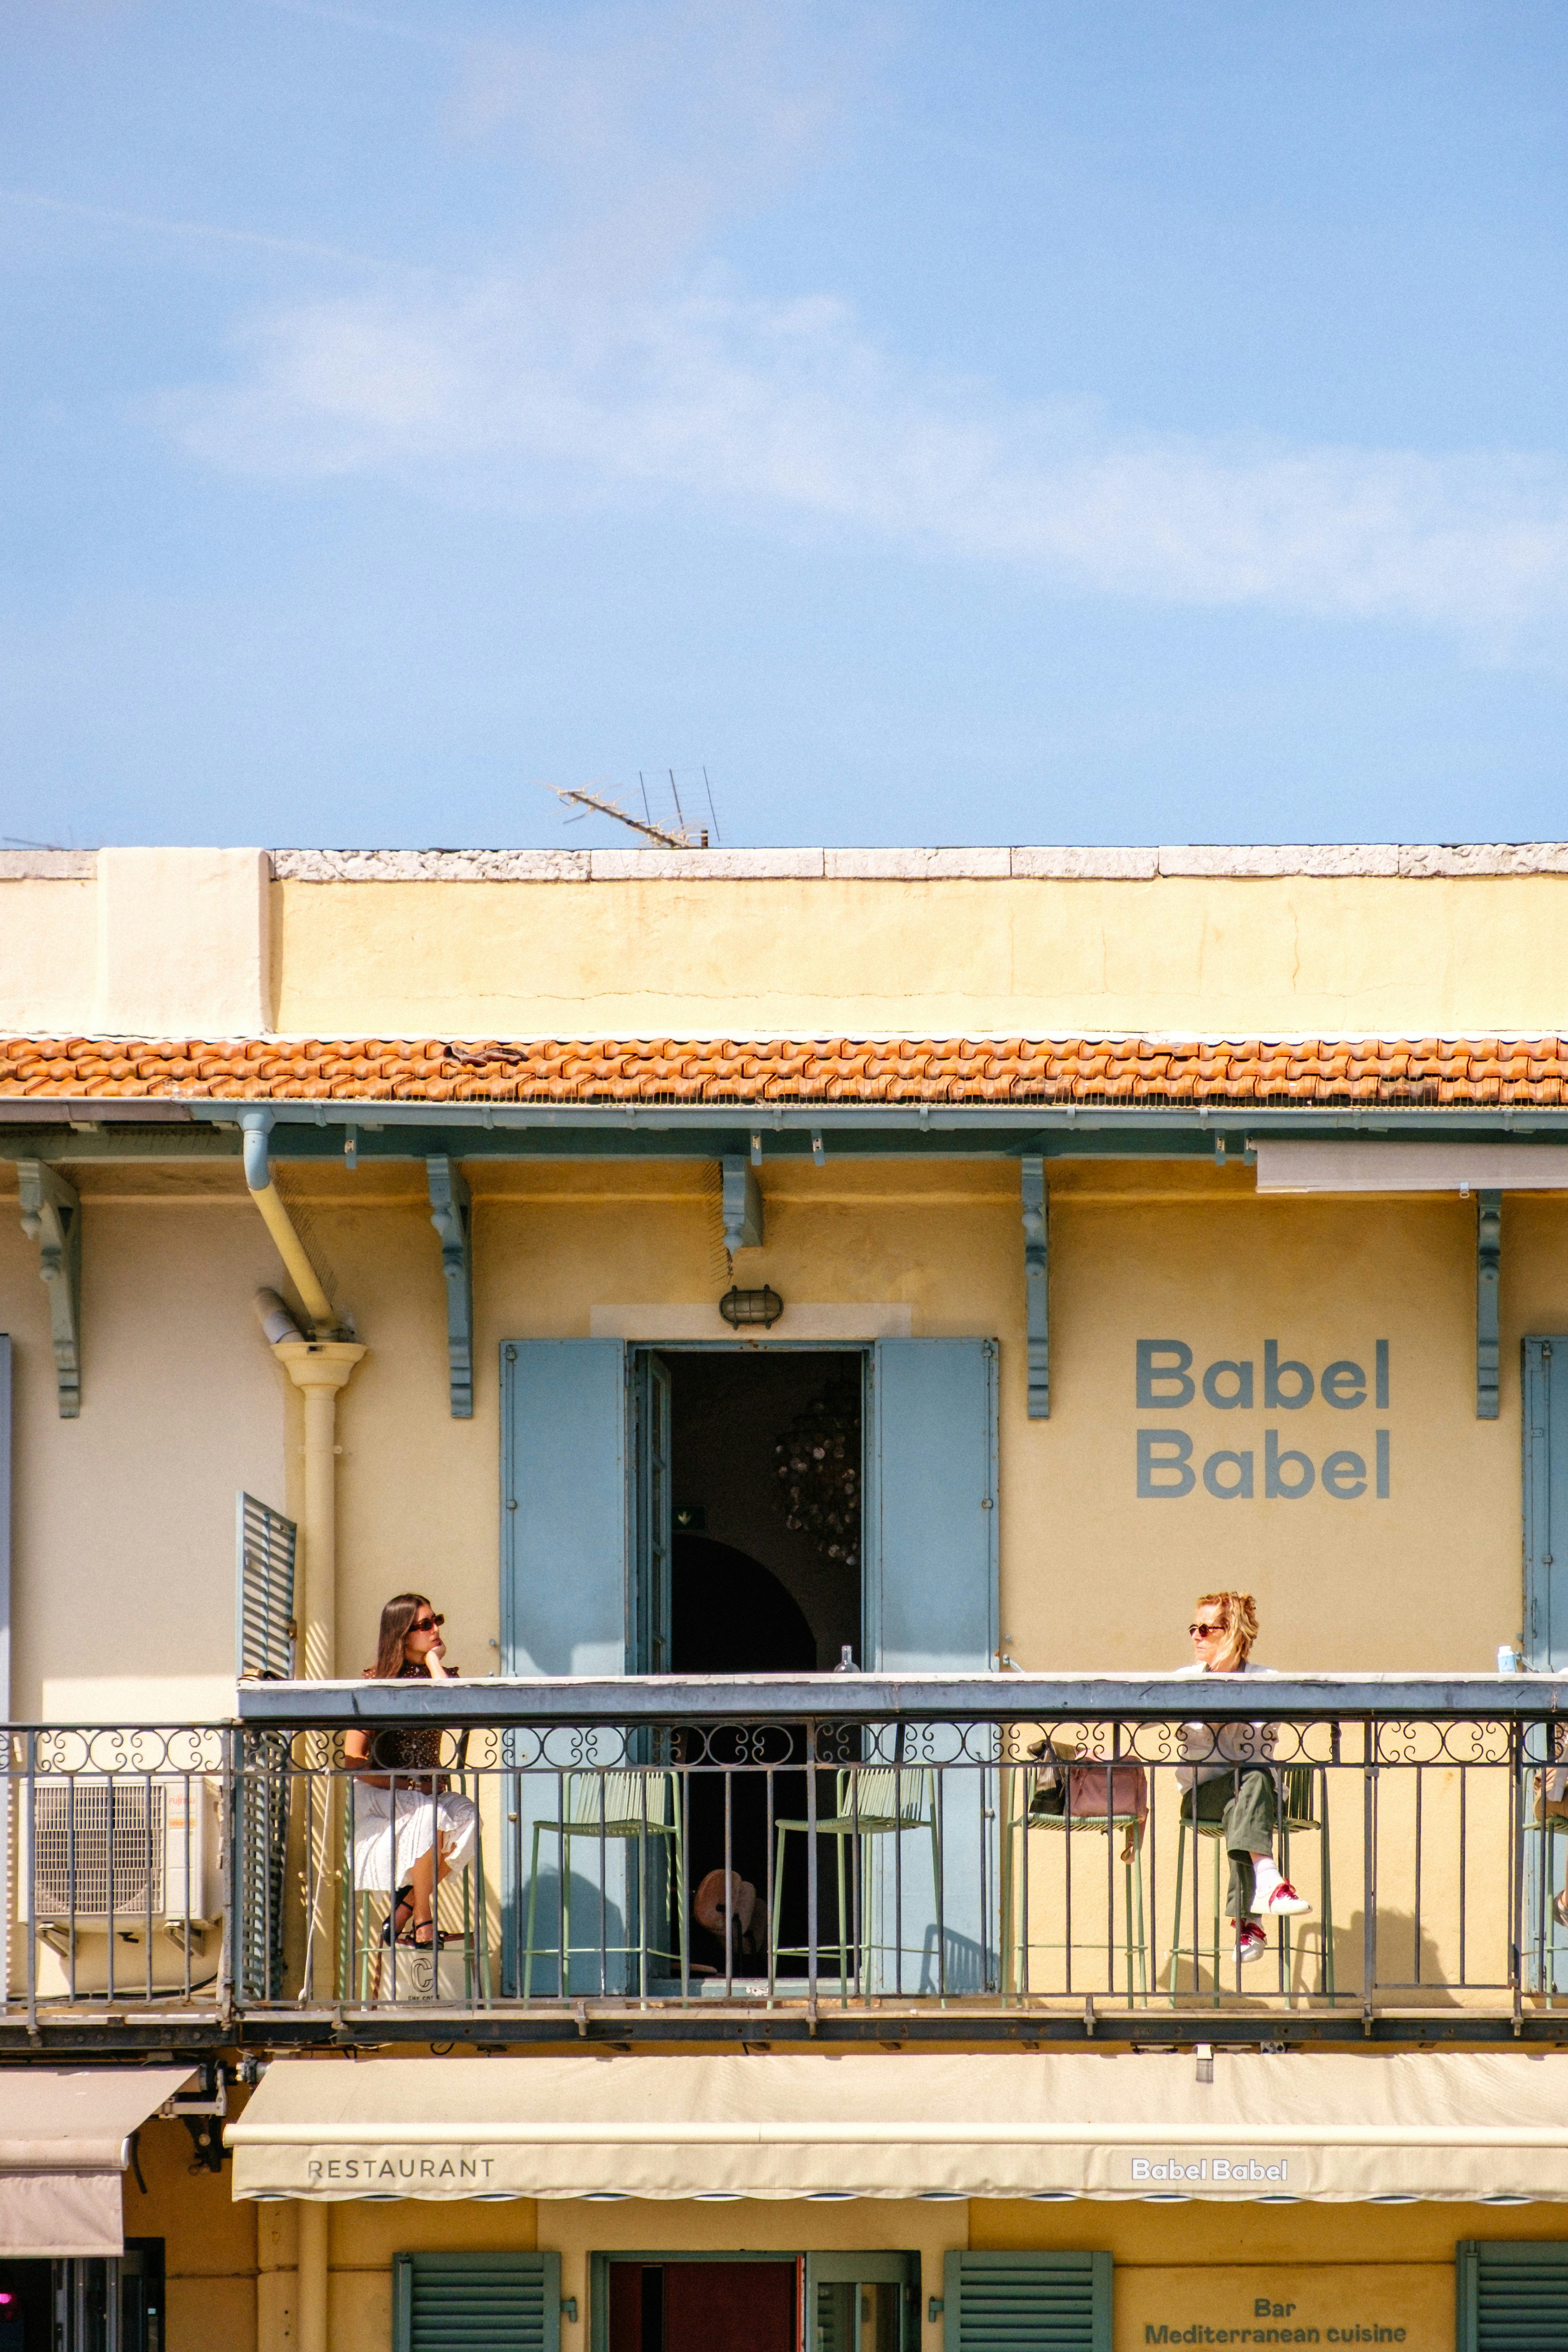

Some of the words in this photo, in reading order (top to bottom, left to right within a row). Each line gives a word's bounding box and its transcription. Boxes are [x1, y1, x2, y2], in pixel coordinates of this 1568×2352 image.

[1136, 1339, 1389, 1409] Babel
[1136, 1429, 1390, 1499] Babel
[308, 2159, 494, 2178] RESTAURANT
[1132, 2159, 1206, 2180] Babel
[1212, 2159, 1287, 2181] Babel
[1254, 2298, 1296, 2317] Bar
[1145, 2325, 1320, 2344] Mediterranean
[1326, 2324, 1406, 2342] cuisine
